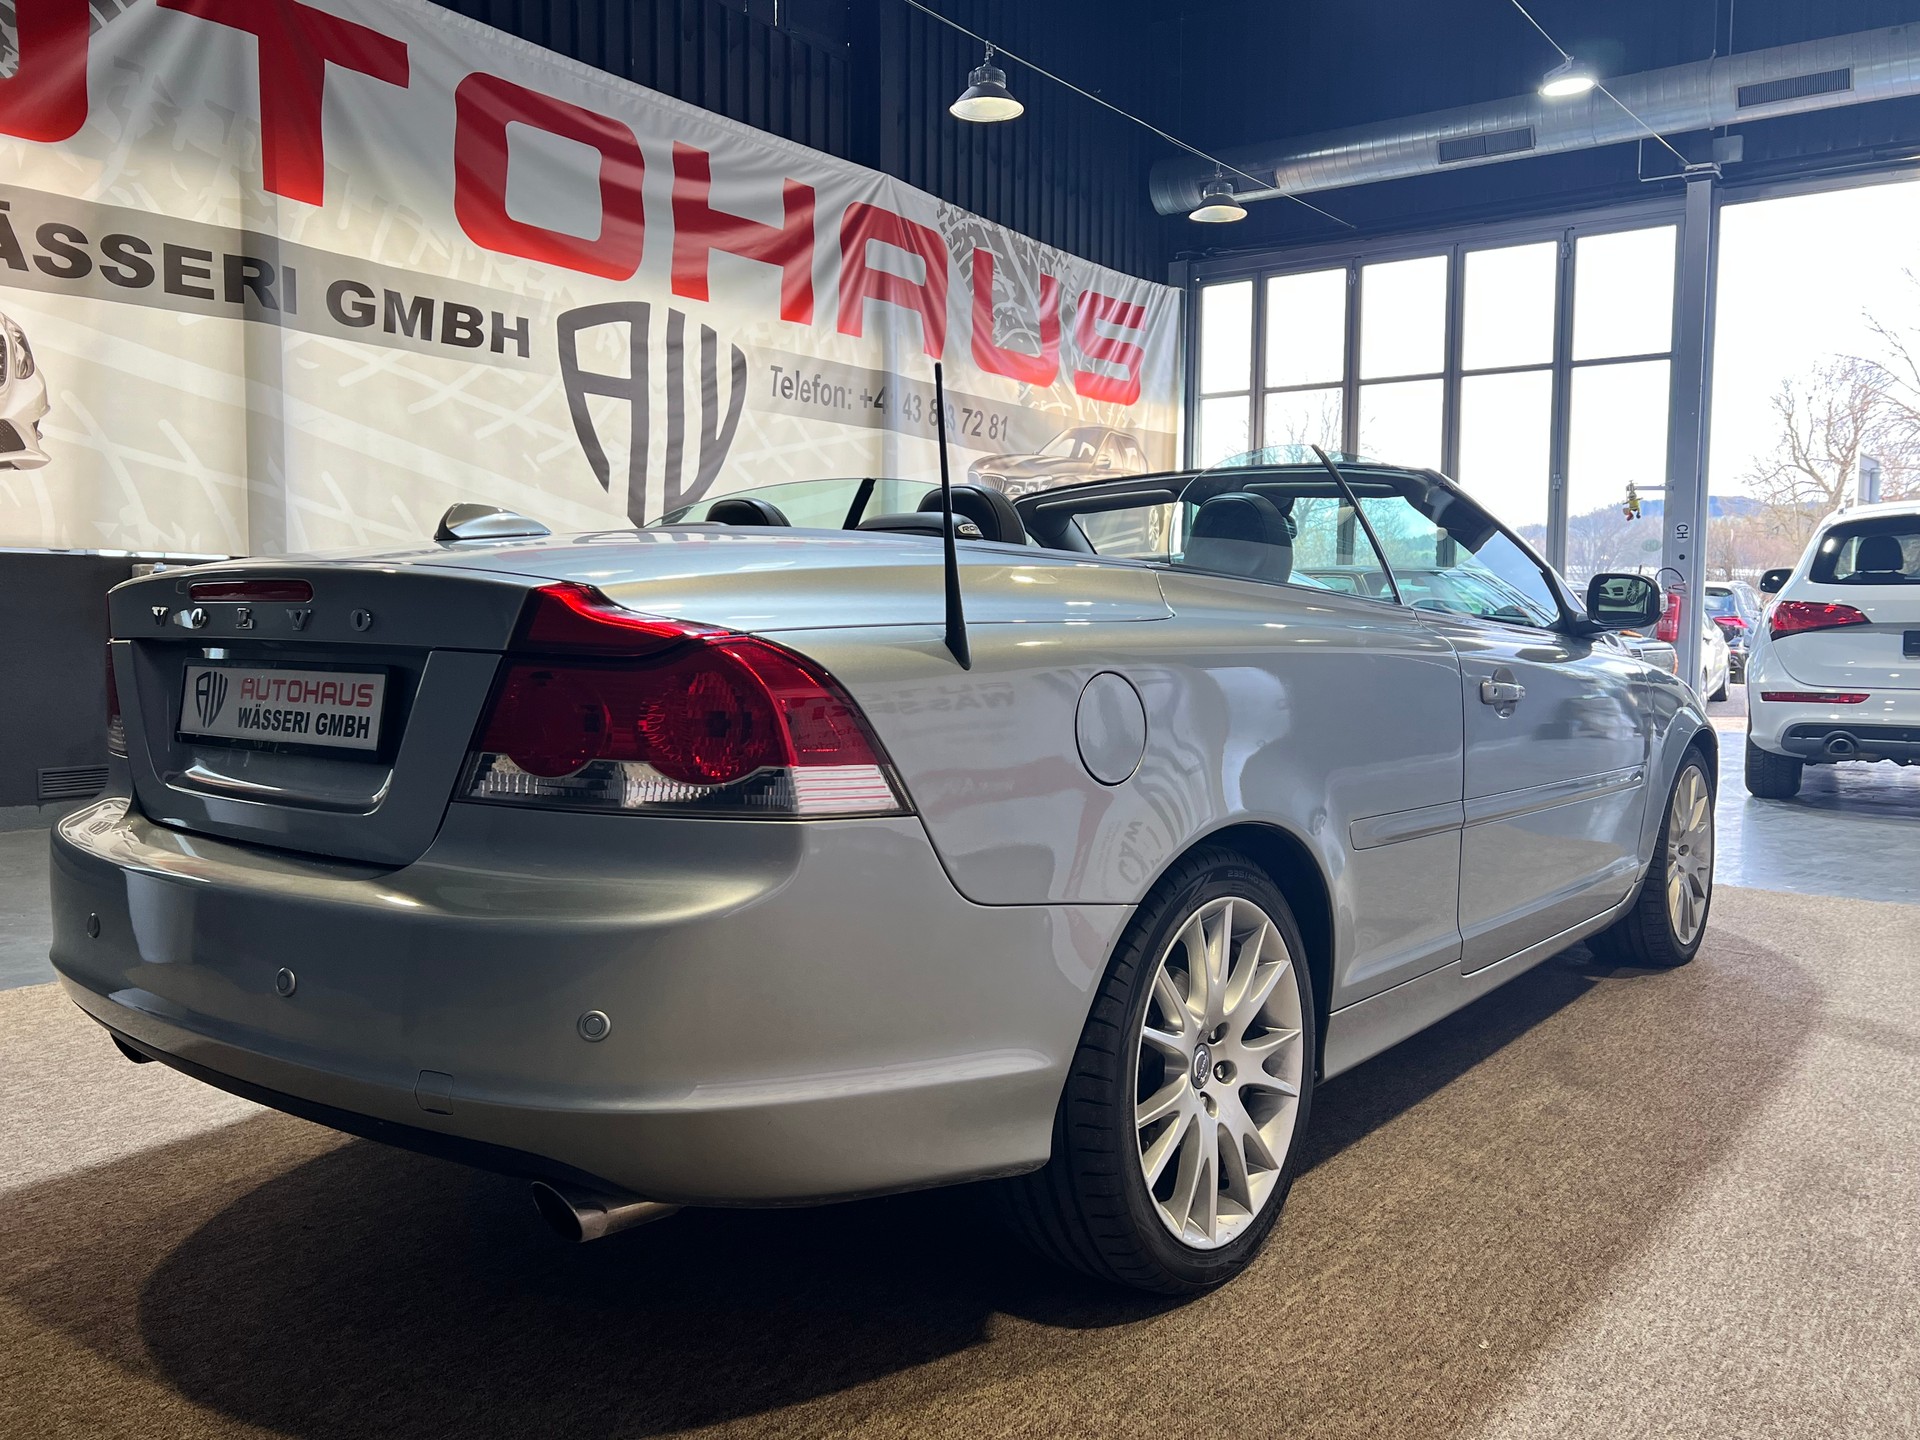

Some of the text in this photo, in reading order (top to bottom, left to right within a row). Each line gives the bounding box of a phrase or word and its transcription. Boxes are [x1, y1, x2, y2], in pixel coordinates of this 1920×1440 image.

[326, 279, 530, 359] GMBH
[770, 365, 852, 410] Telefon:
[860, 384, 894, 414] +4
[902, 392, 922, 423] 43
[961, 407, 984, 437] 72
[988, 413, 1009, 442] 81
[1676, 524, 1689, 539] CH
[151, 606, 374, 632] VOLVO
[240, 677, 375, 708] AUTOHAUS
[237, 704, 371, 739] WÄSSERI GMBH
